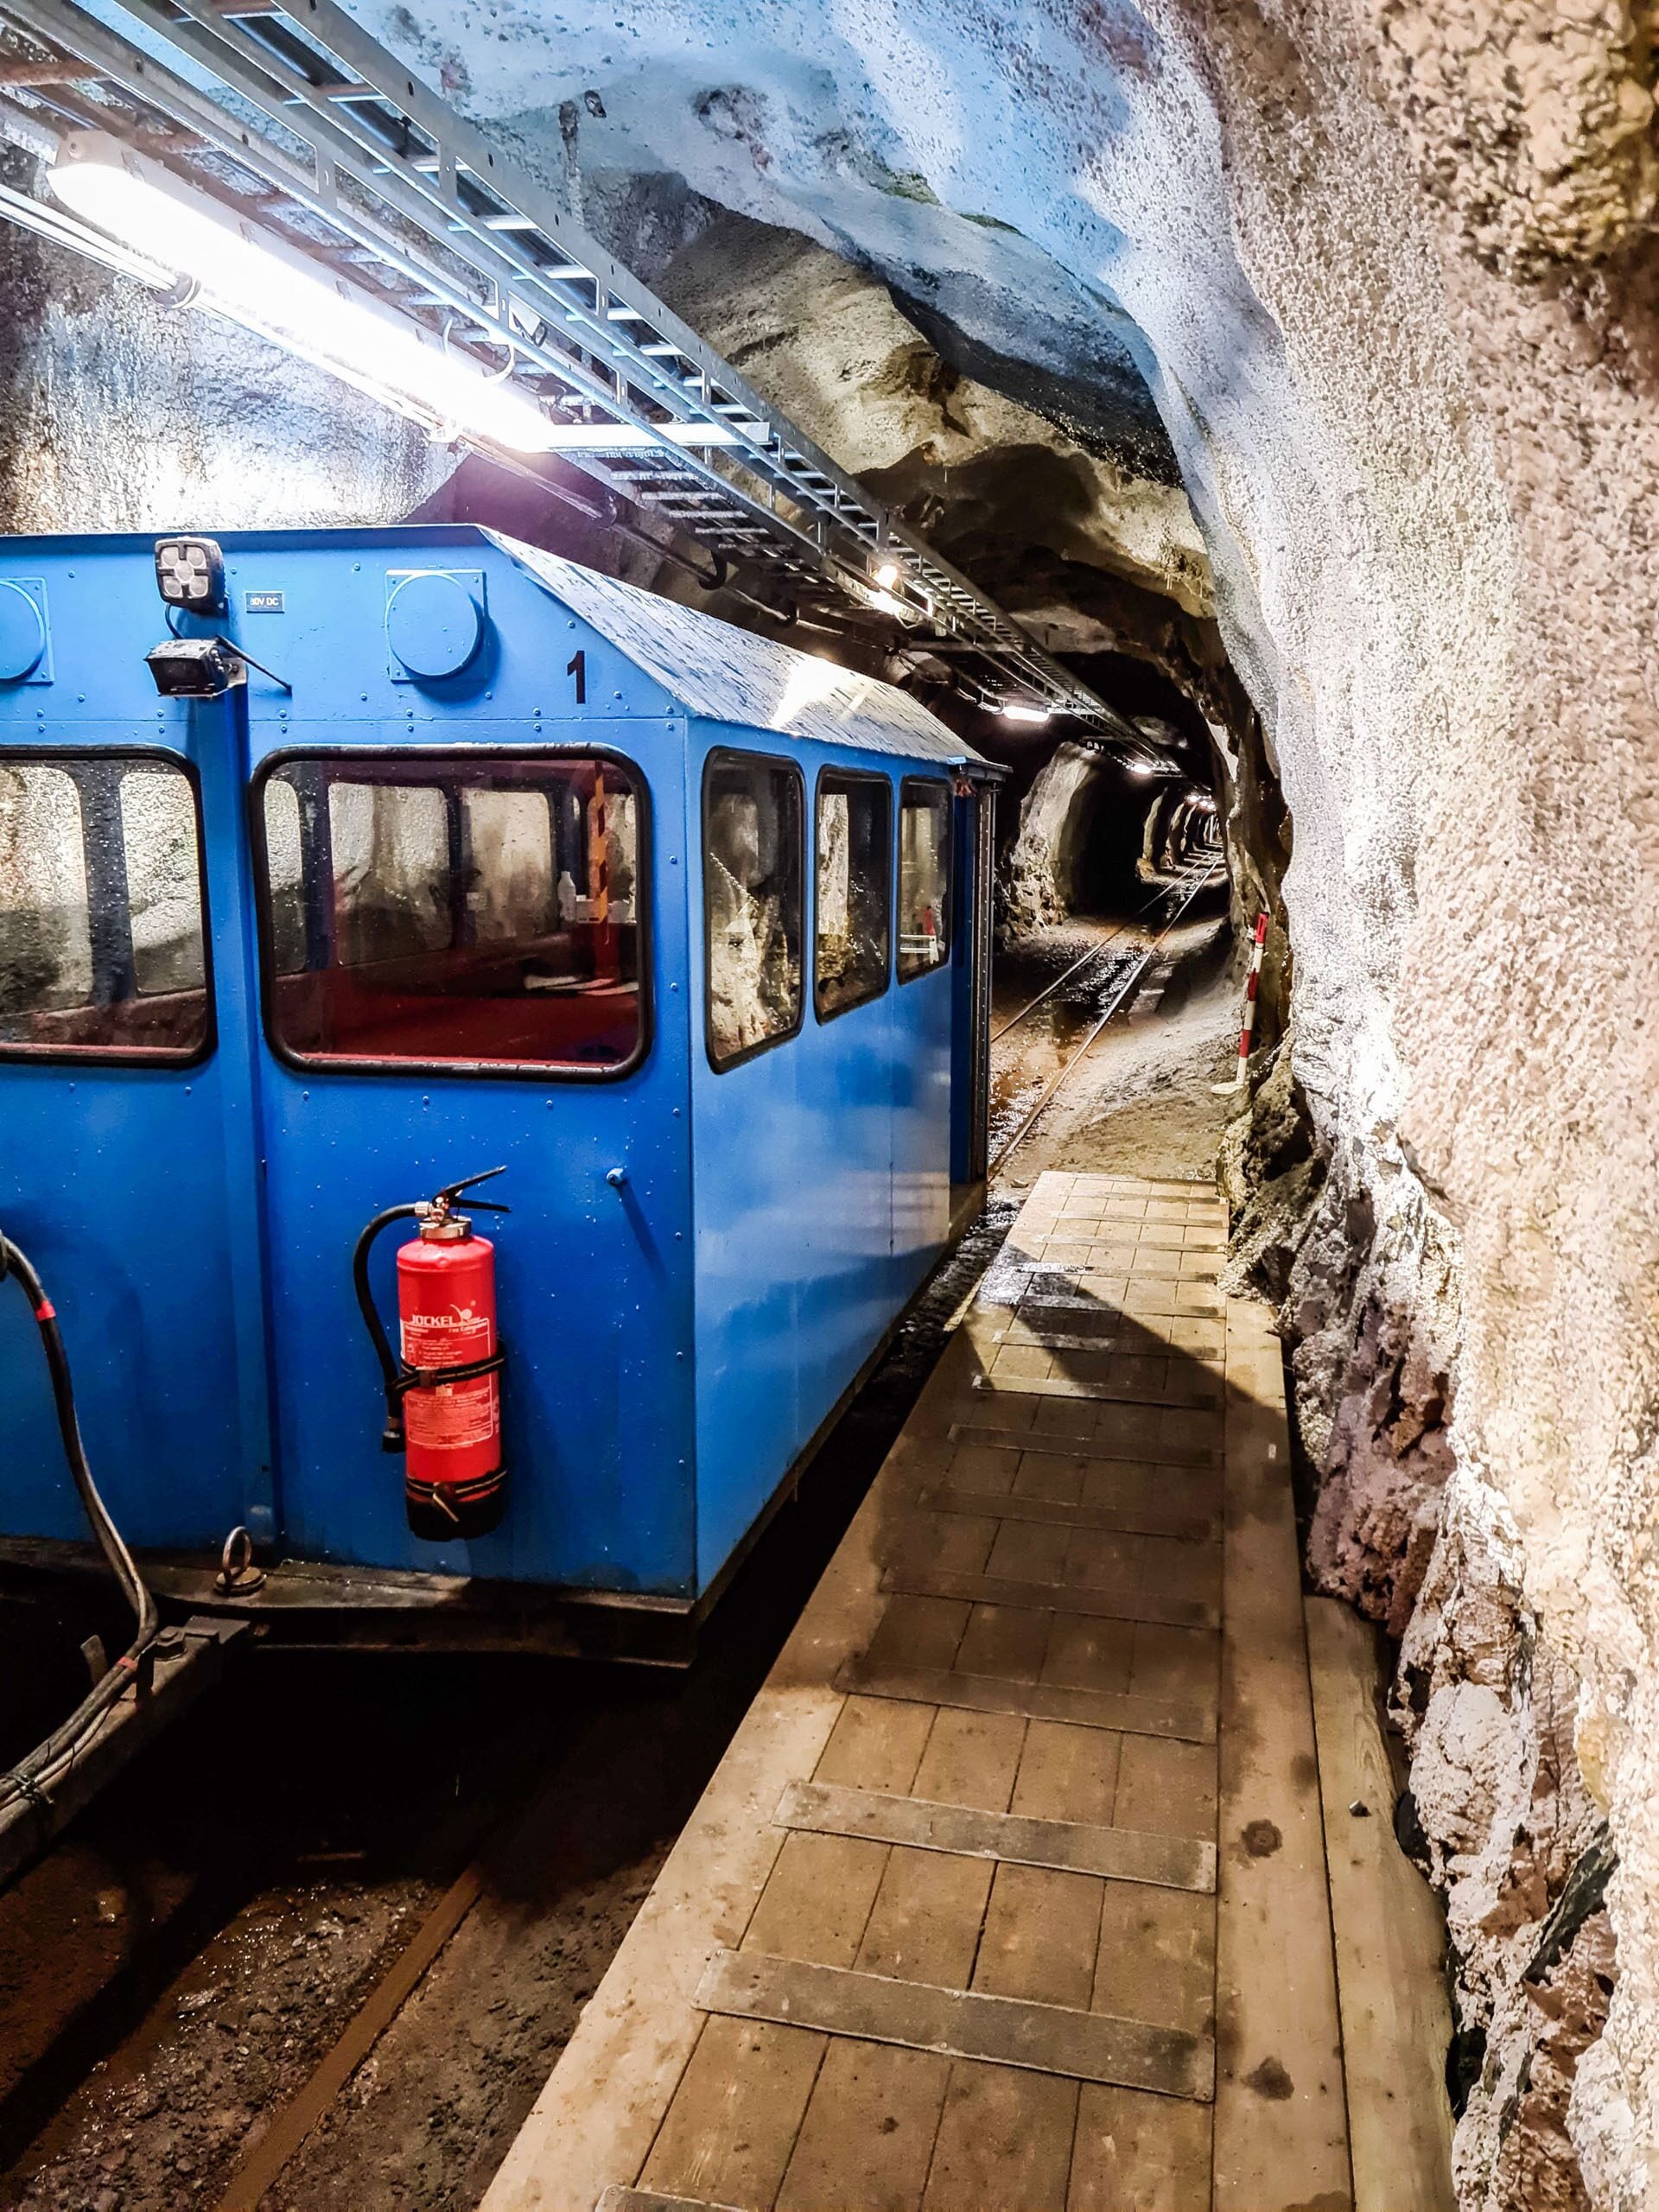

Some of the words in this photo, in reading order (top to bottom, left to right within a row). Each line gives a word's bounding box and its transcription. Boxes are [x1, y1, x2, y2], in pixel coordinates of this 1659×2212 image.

[266, 597, 279, 606] DC
[567, 650, 586, 704] 1
[411, 1314, 456, 1327] JOCKEL
